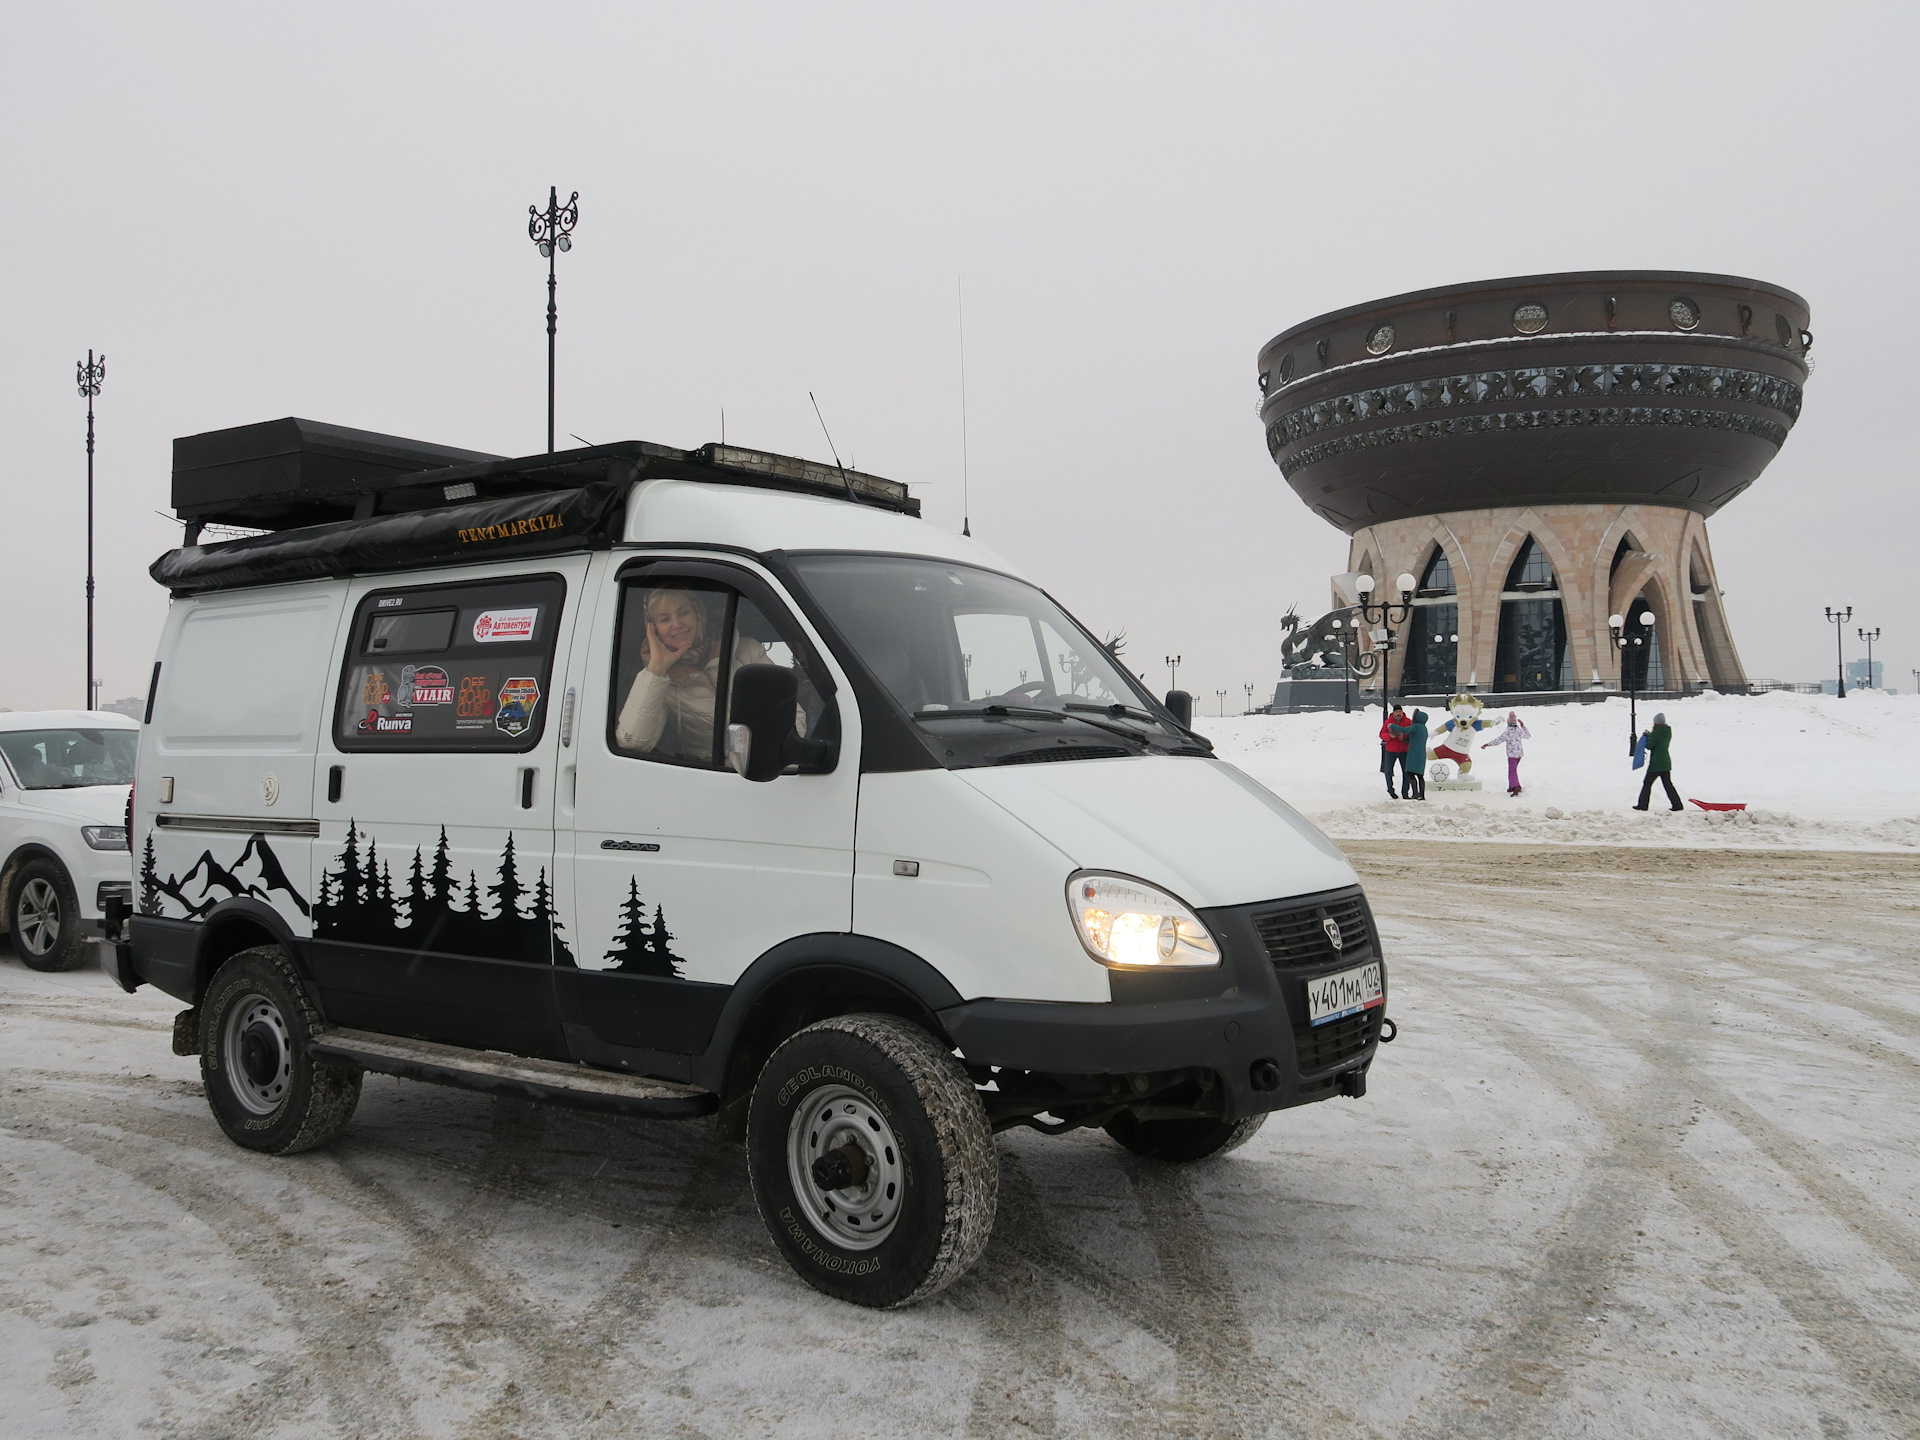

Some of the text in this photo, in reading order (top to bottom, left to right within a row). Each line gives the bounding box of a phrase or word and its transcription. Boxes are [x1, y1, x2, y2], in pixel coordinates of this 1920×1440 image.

[457, 512, 564, 544] TENTMARKIZA
[378, 597, 404, 608] DRIVE2.RU
[492, 621, 532, 631] Автовентури
[461, 676, 486, 692] OFF
[415, 689, 452, 702] VIAIR
[458, 689, 491, 705] ROAD
[456, 702, 482, 717] CLUB
[377, 717, 412, 731] Runva
[601, 840, 660, 852] Соболь
[1312, 966, 1378, 1014] У401МА 102
[207, 978, 251, 1071] GEOLANDAR
[777, 1064, 893, 1118] GEOLANDAR
[778, 1206, 882, 1276] YOKOHAMA
